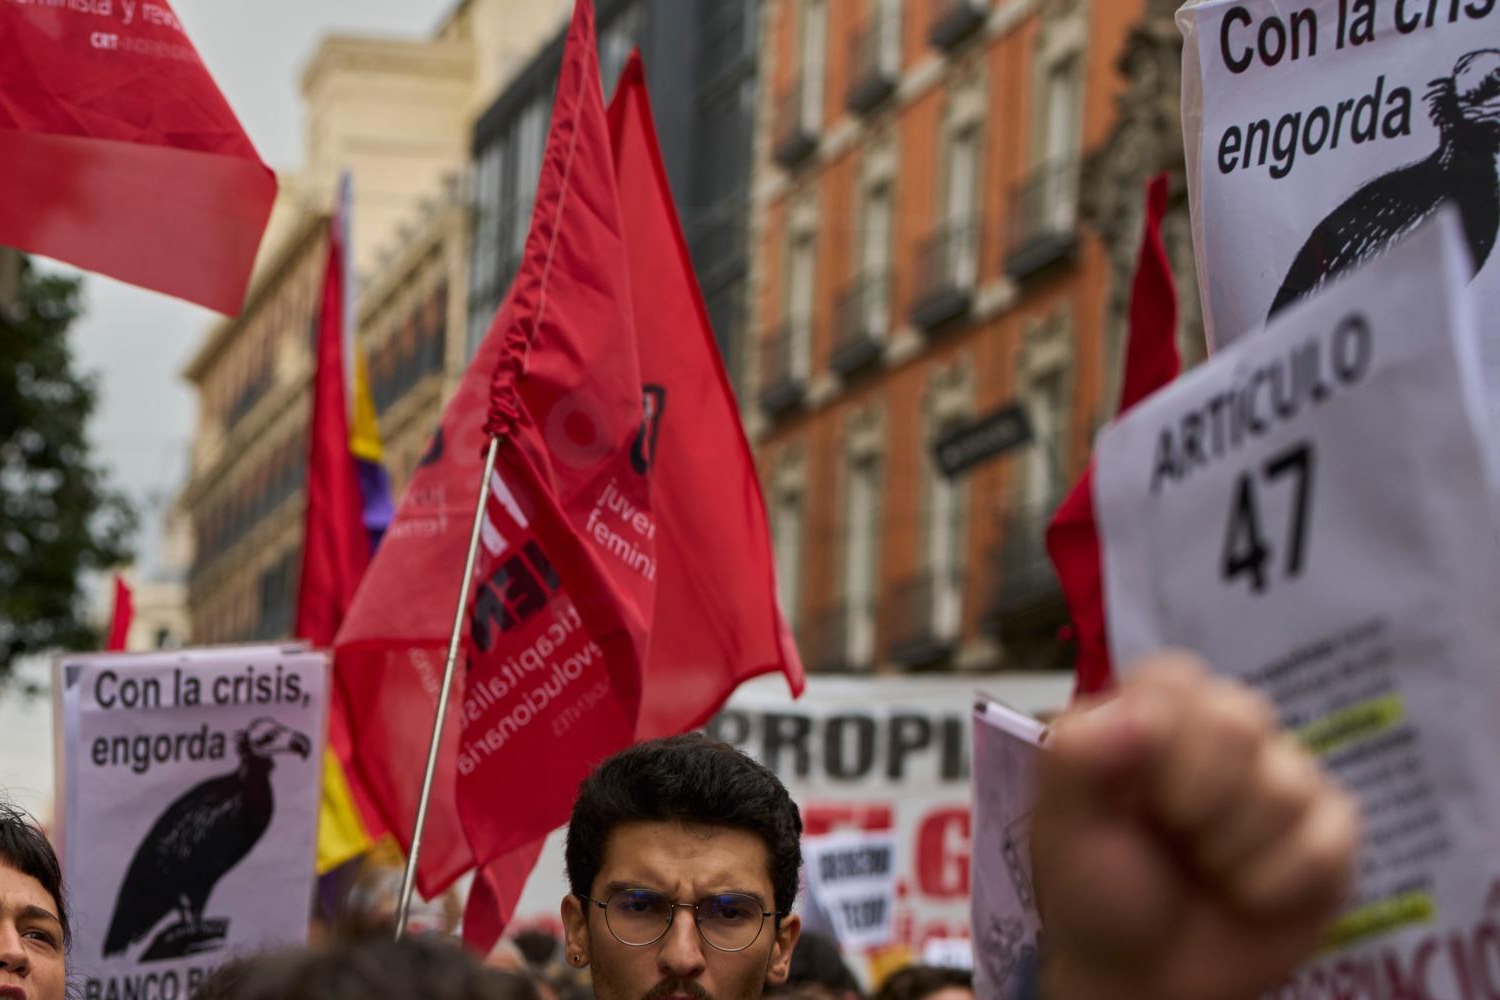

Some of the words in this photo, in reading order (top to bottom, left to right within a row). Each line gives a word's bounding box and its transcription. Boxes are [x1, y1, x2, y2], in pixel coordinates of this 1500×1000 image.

[1219, 6, 1318, 74] Con
[1335, 0, 1376, 50] la
[1217, 75, 1412, 180] engorda
[1219, 436, 1317, 596] 47
[94, 670, 161, 709] Con
[173, 669, 201, 707] la
[211, 665, 312, 708] crisis,
[91, 724, 227, 774] engorda
